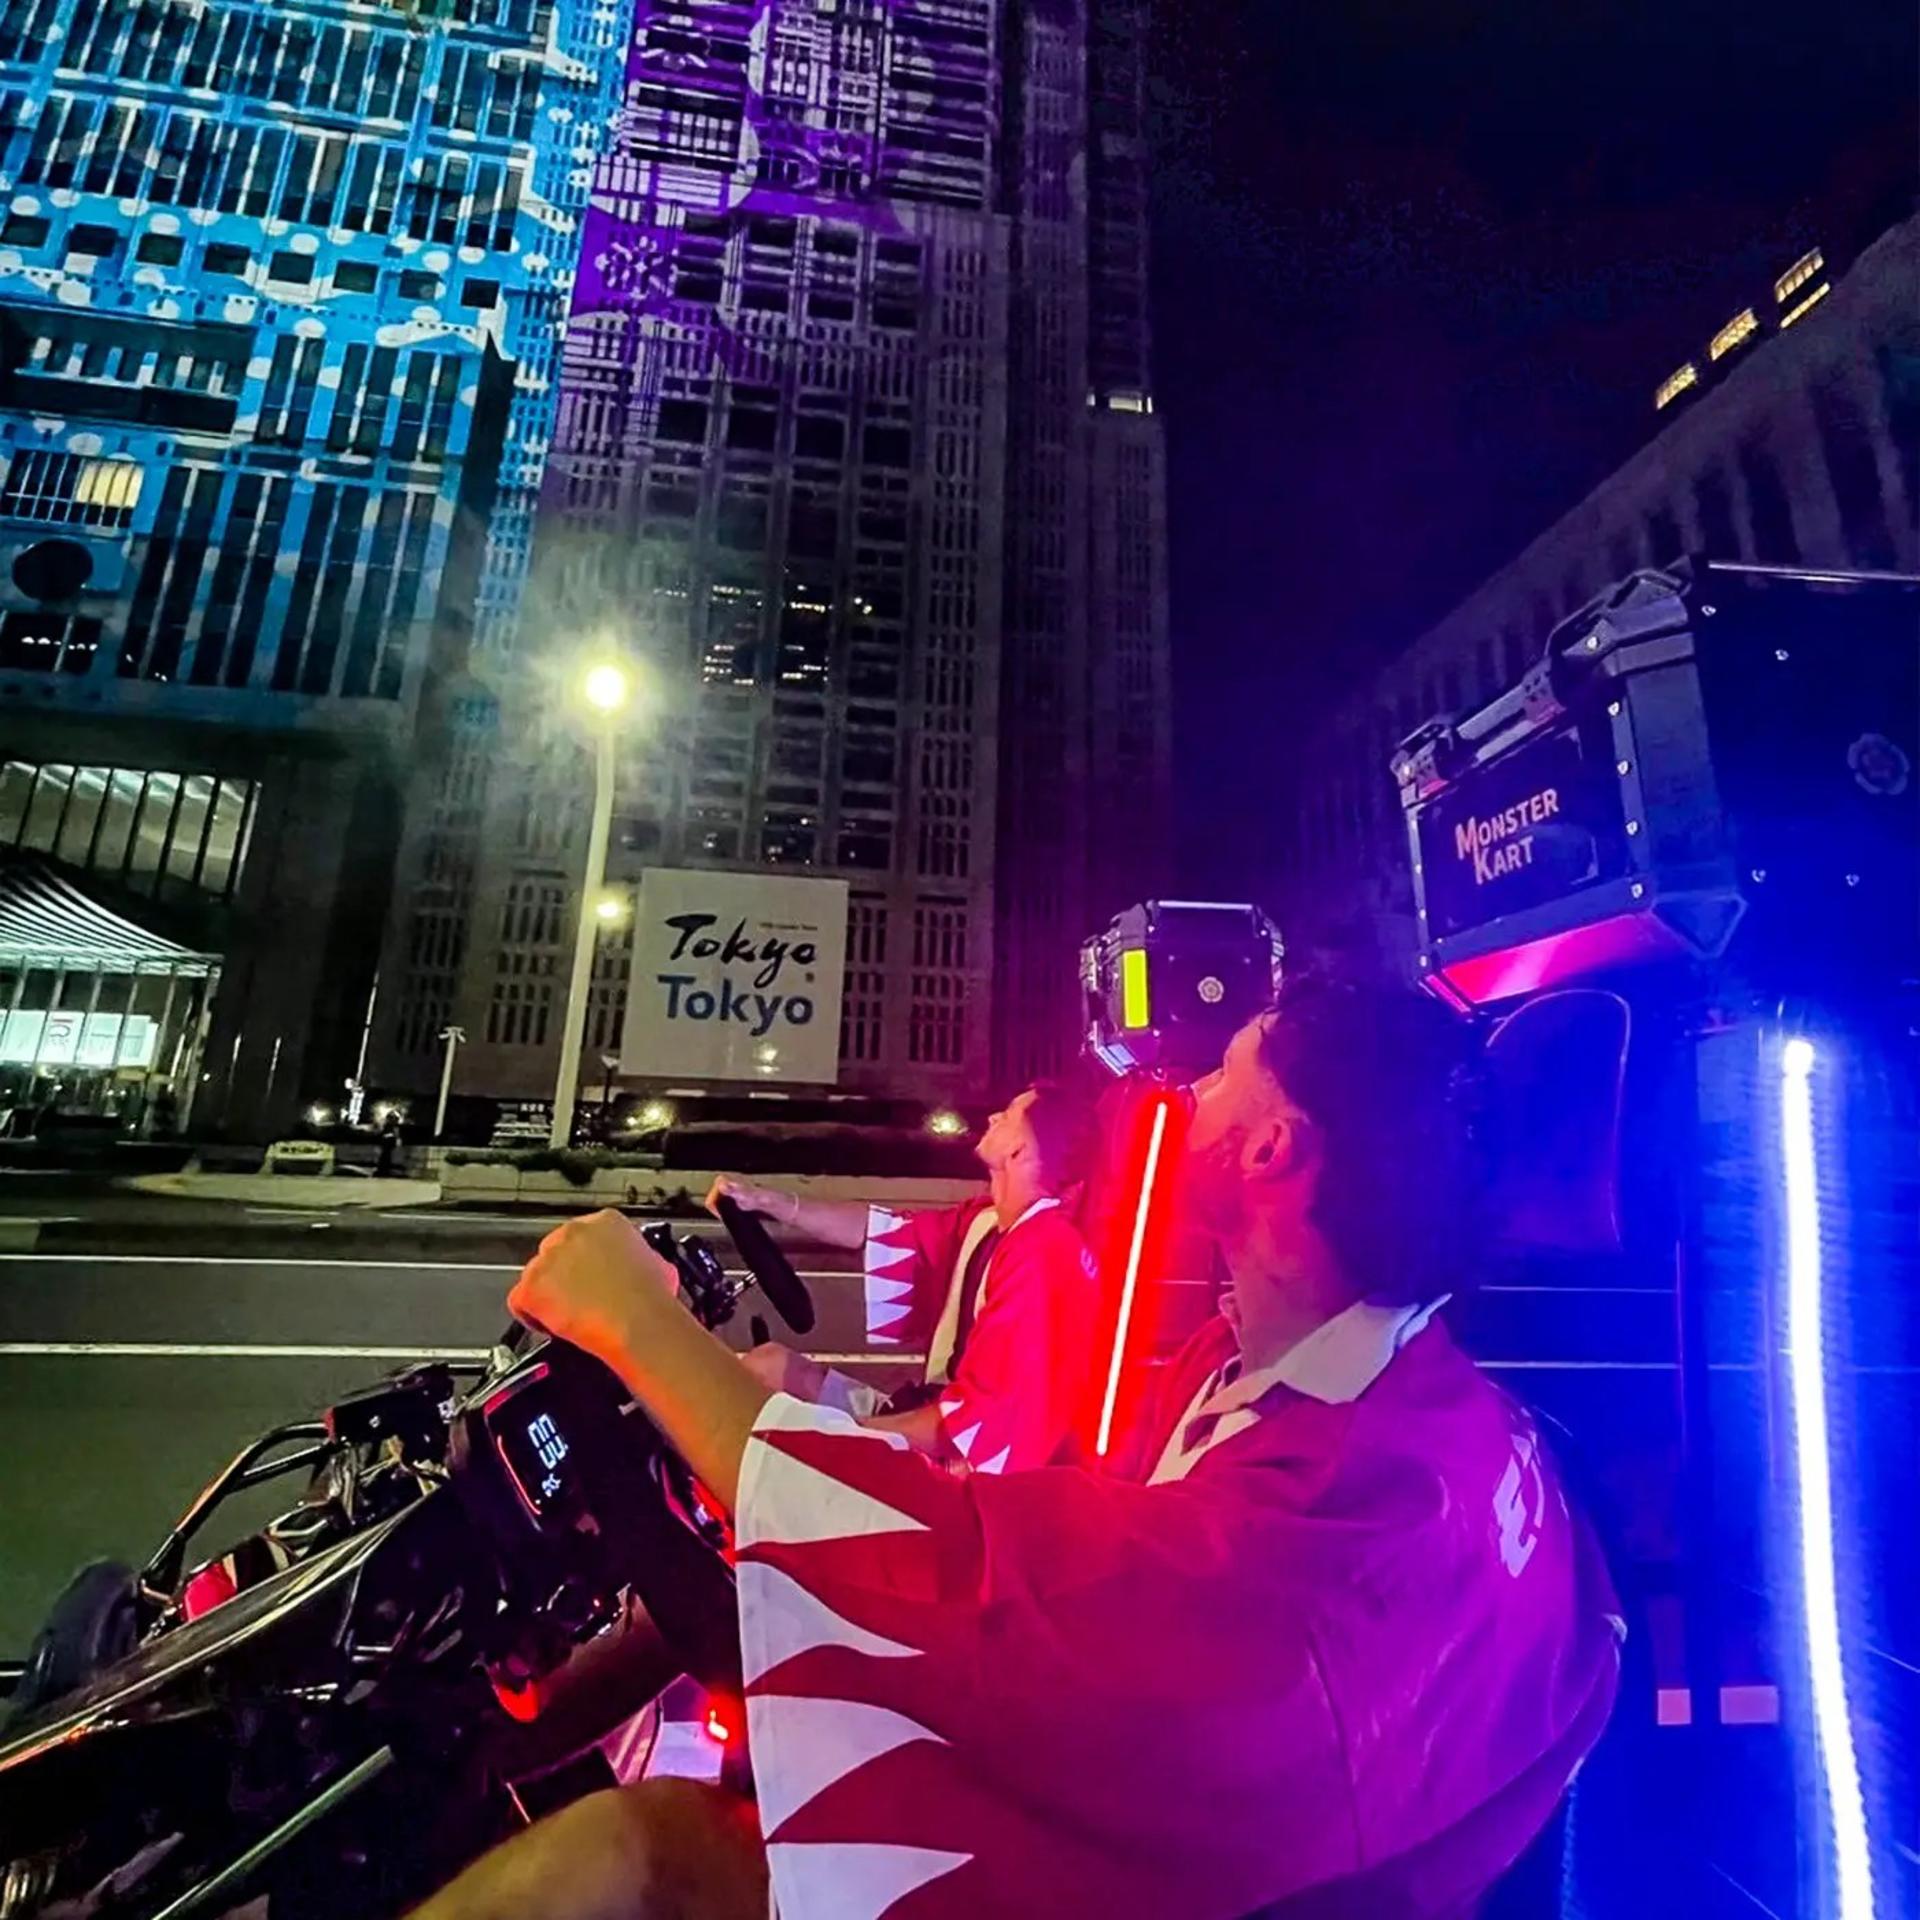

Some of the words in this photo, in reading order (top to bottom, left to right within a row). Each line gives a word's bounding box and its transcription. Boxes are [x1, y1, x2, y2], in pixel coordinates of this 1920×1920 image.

[1454, 788, 1560, 861] MONSTER
[1474, 835, 1534, 886] KART
[664, 913, 818, 989] Tokyo
[656, 973, 814, 1037] Tokyo
